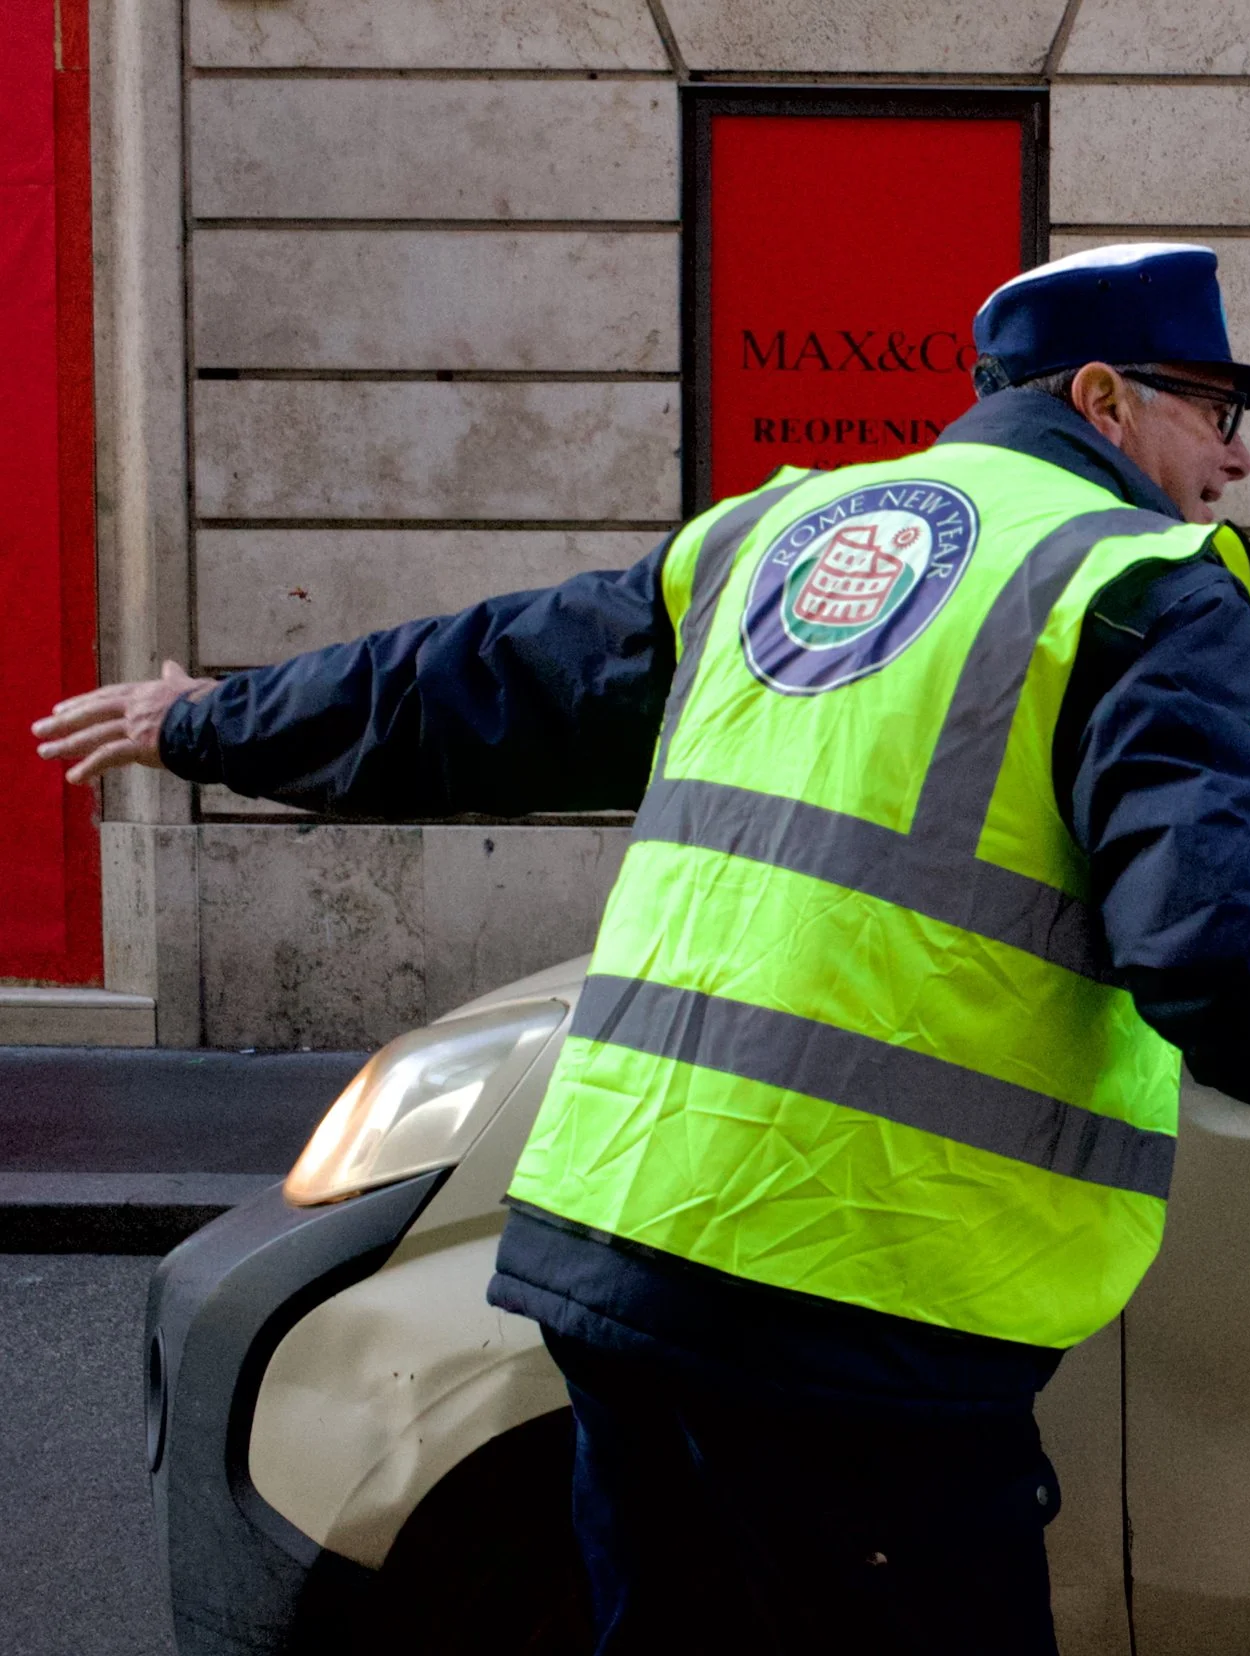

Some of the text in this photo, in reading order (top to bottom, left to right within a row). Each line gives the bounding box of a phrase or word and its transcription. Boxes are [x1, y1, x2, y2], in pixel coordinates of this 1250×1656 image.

[752, 416, 943, 445] REOPENIN
[772, 488, 964, 580] ROME NEW YEAR
